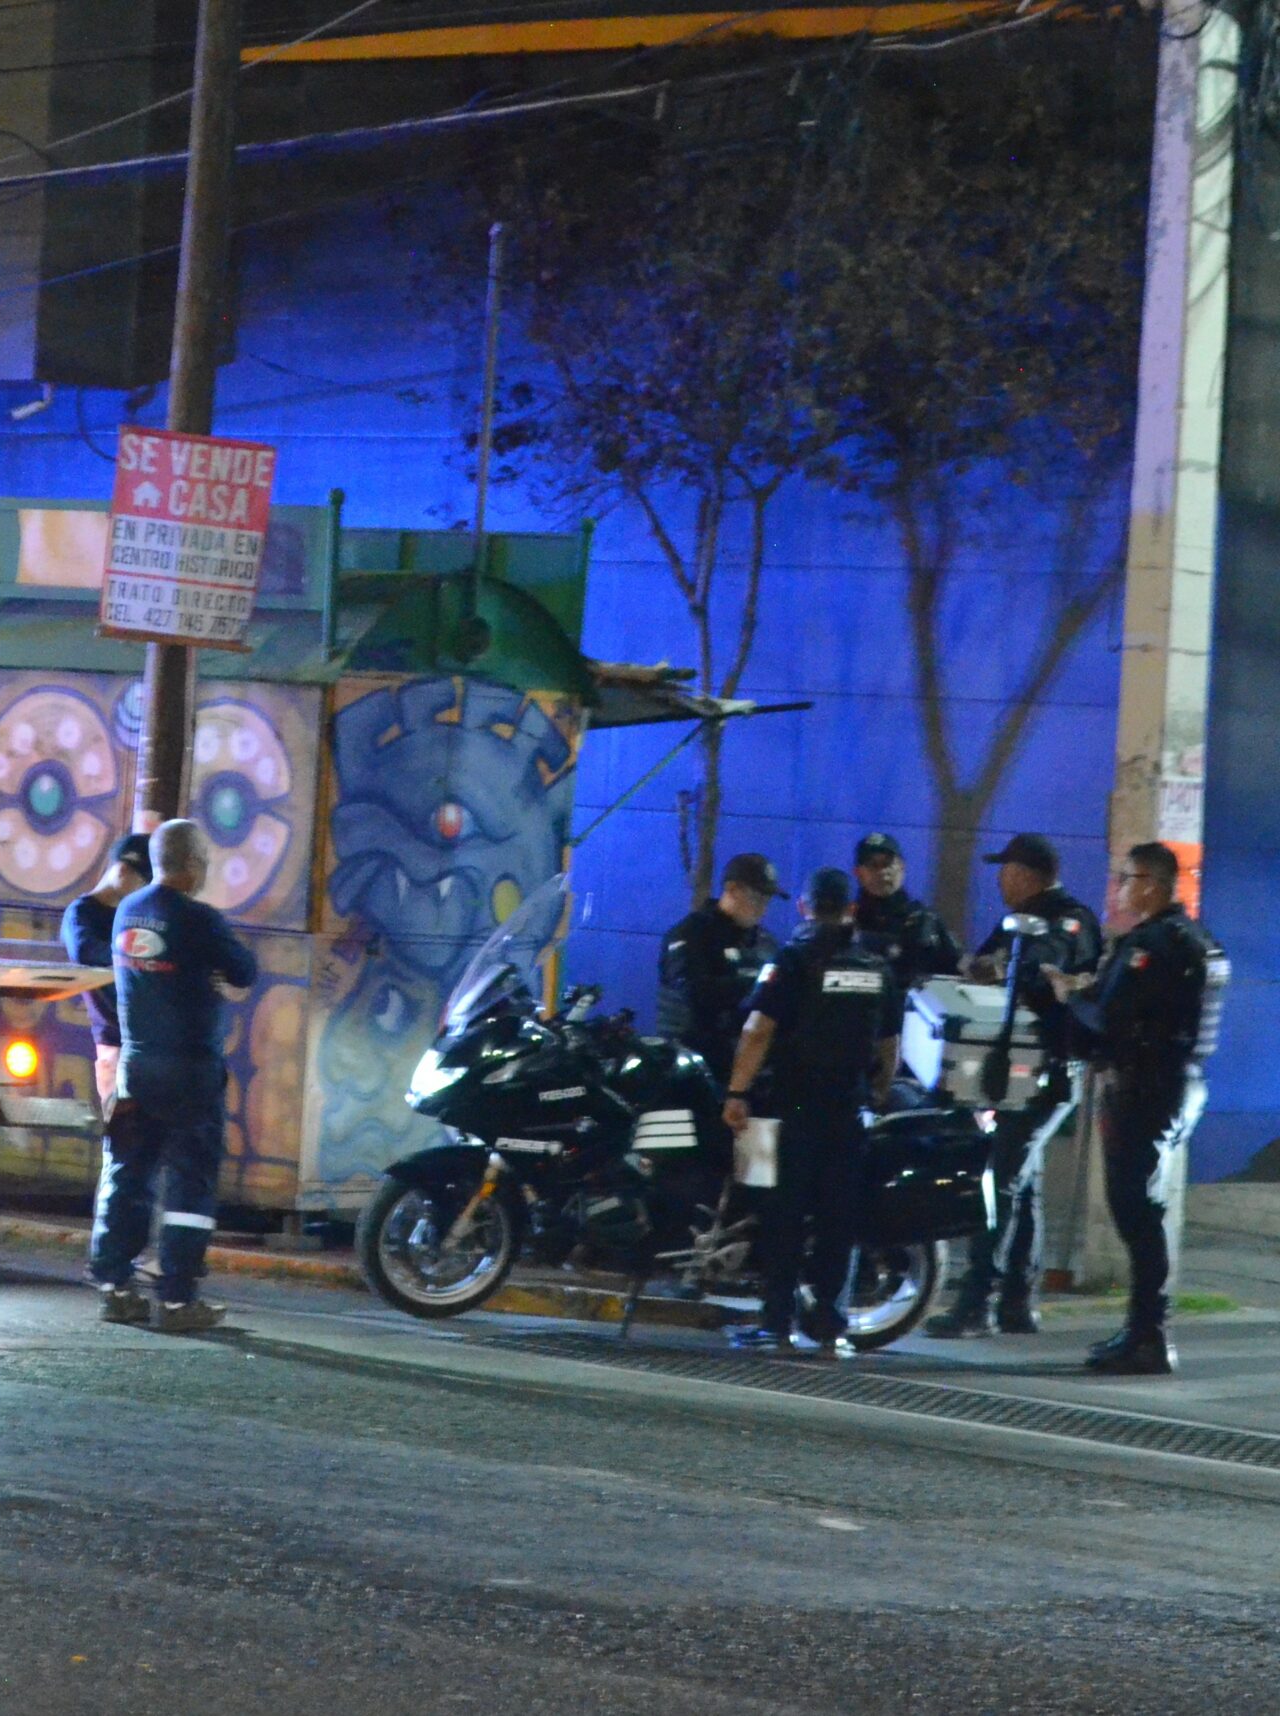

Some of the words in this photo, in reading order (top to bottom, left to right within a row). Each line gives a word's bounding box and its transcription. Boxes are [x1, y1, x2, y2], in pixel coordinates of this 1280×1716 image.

[120, 433, 161, 474] SE
[170, 440, 274, 487] VENDE
[169, 479, 249, 523] CASA
[114, 519, 136, 542] EN
[144, 523, 225, 551] PRIVADA
[234, 534, 258, 556] EN
[113, 546, 169, 569] CENTRO
[108, 580, 161, 603] TRATO
[173, 588, 248, 613] DIRECTO
[144, 607, 172, 627] 427
